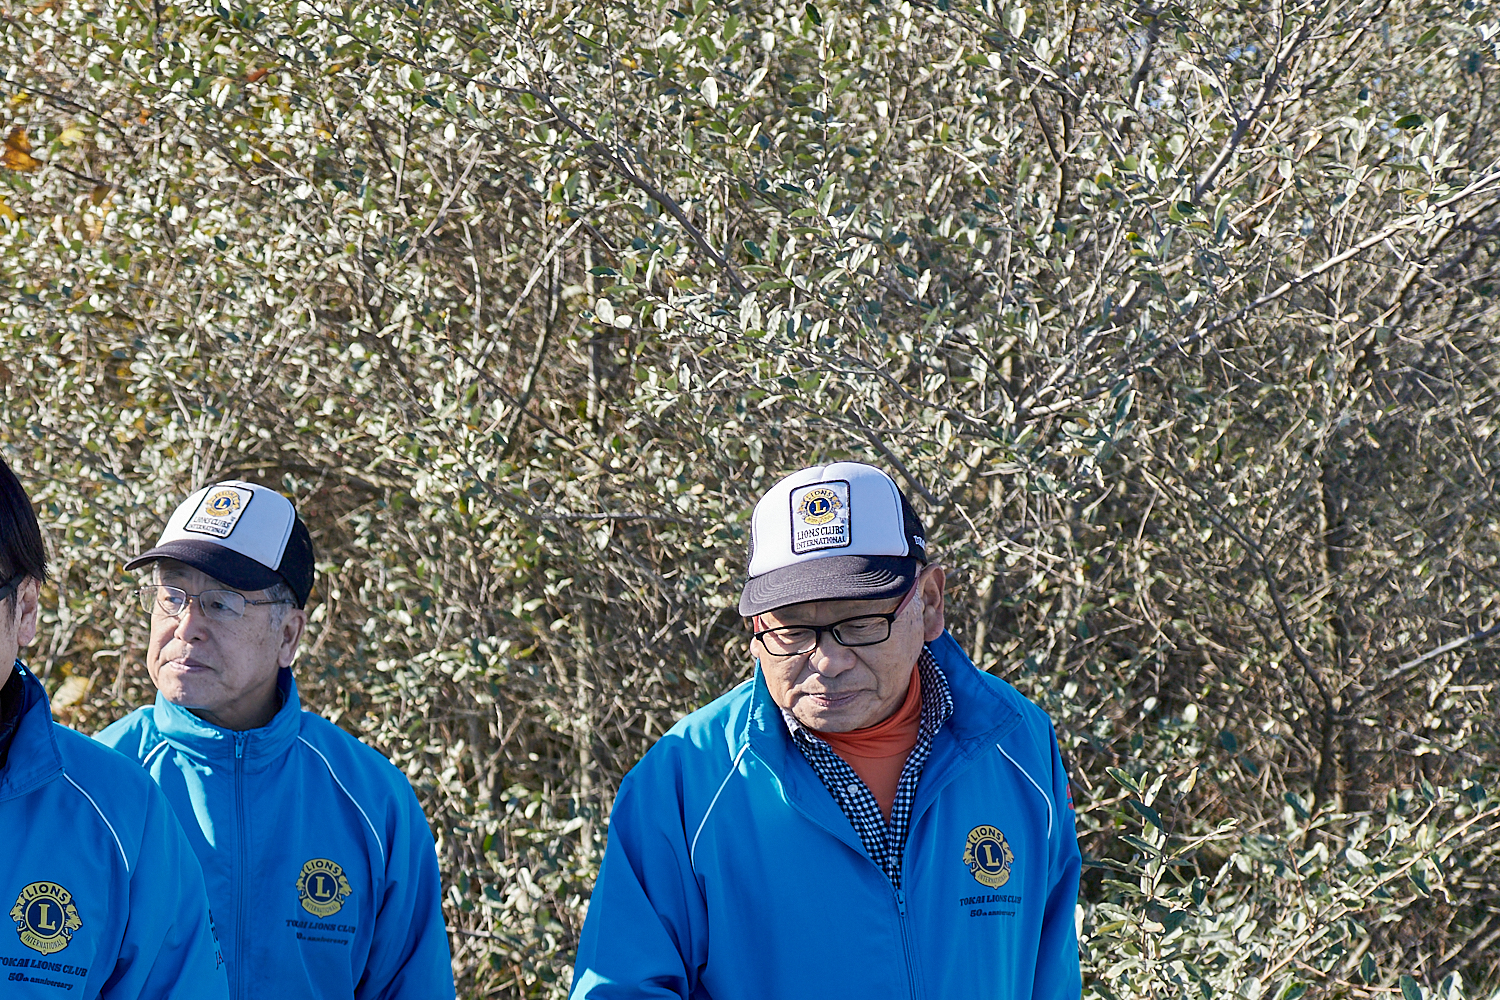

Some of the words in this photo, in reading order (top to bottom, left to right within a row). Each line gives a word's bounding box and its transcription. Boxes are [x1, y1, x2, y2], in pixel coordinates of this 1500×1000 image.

[216, 498, 228, 509] L
[813, 500, 826, 514] L
[797, 527, 820, 541] LIONS
[820, 525, 845, 536] CLUBS
[796, 535, 846, 550] INTERNATIONAL
[970, 827, 1002, 841] LIONS
[983, 844, 1000, 867] L
[305, 860, 340, 875] LIONS
[25, 883, 68, 902] LIONS
[315, 876, 330, 898] L
[959, 895, 986, 907] TOKAI
[986, 894, 1007, 904] LIONS
[38, 903, 56, 930] L
[308, 921, 336, 931] LIONS
[23, 934, 64, 950] INTERNATIONAL
[29, 958, 62, 972] LIONS
[62, 964, 88, 977] CLUB
[30, 977, 73, 991] anniversary
